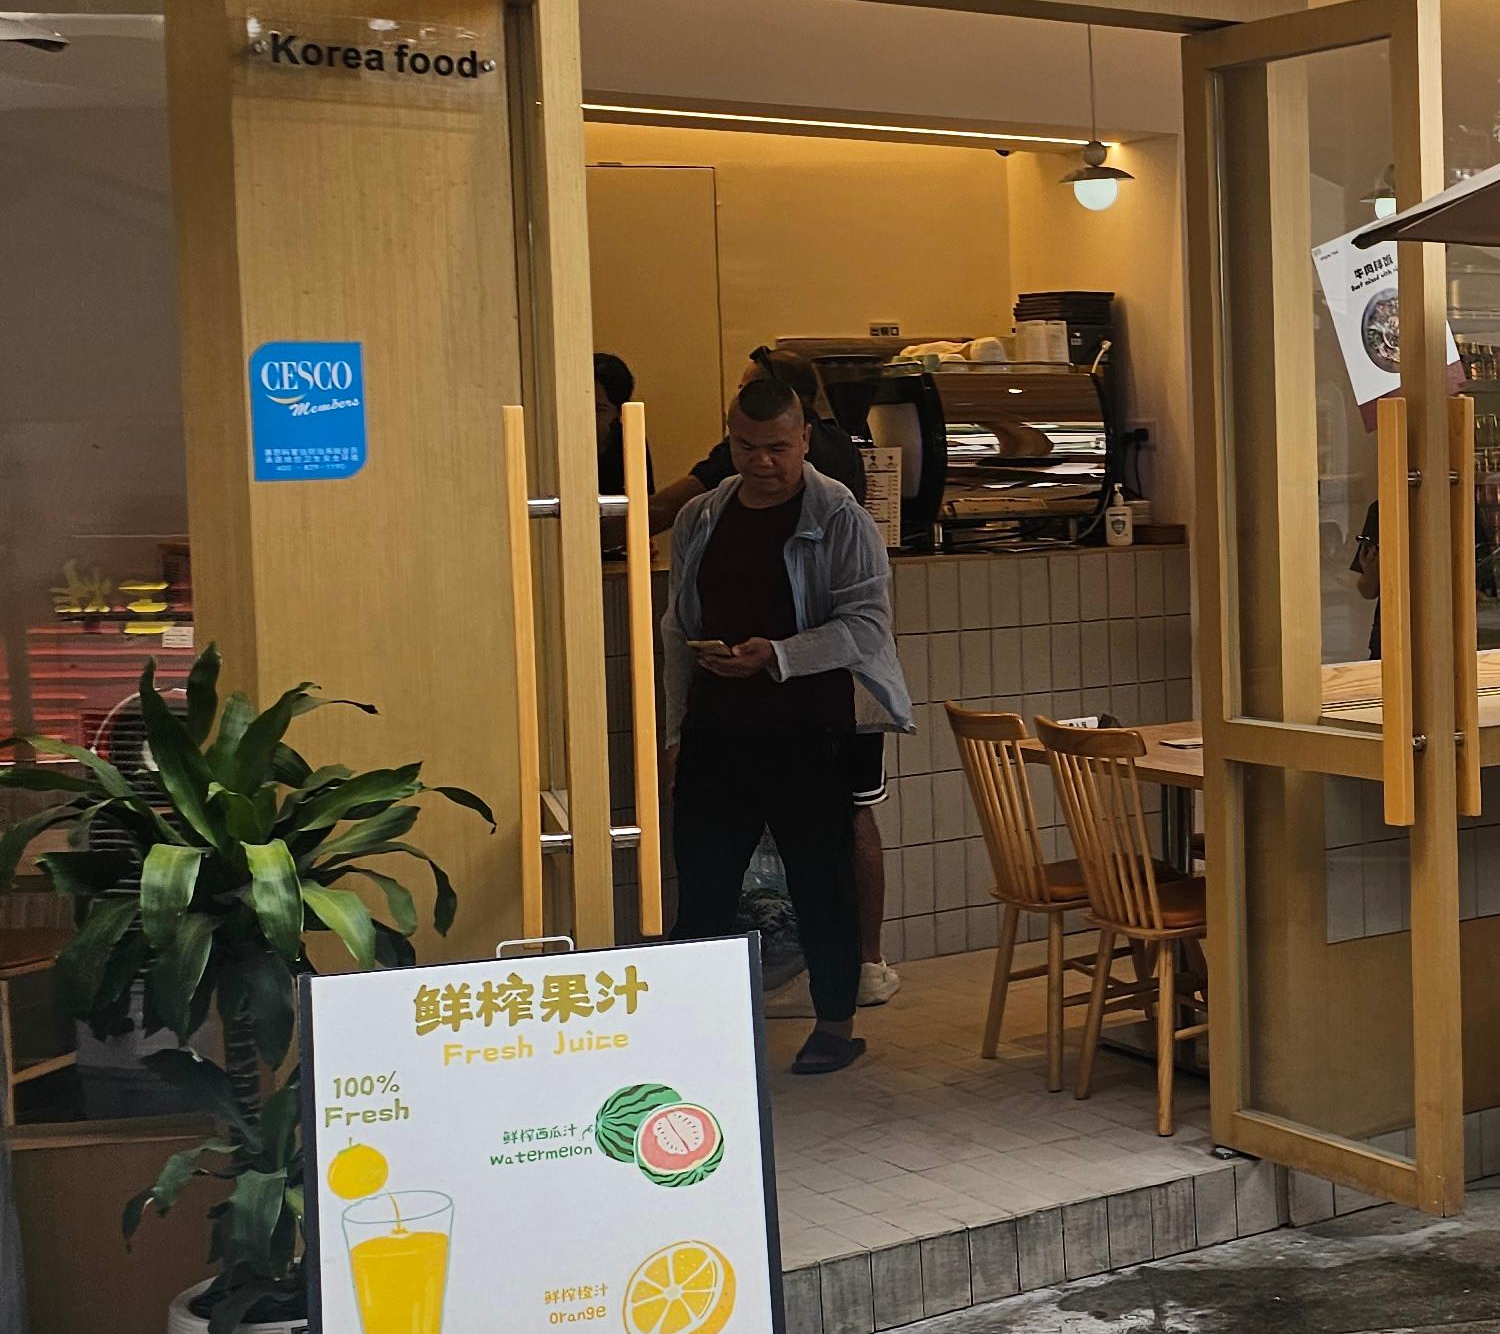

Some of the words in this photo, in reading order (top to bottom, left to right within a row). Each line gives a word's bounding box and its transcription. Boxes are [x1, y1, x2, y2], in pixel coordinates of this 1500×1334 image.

[270, 32, 384, 71] Korea
[394, 44, 479, 79] food
[261, 361, 352, 390] CESCO
[289, 398, 360, 417] Members
[413, 965, 648, 1036] 鲜榨果汁
[442, 1035, 534, 1066] Fresh
[552, 1029, 629, 1055] Juice
[333, 1070, 400, 1099] 100%
[324, 1098, 410, 1128] Fresh
[503, 1123, 577, 1144] 鲜榨西瓜汁
[545, 1283, 609, 1305] 鲜榨橙汁
